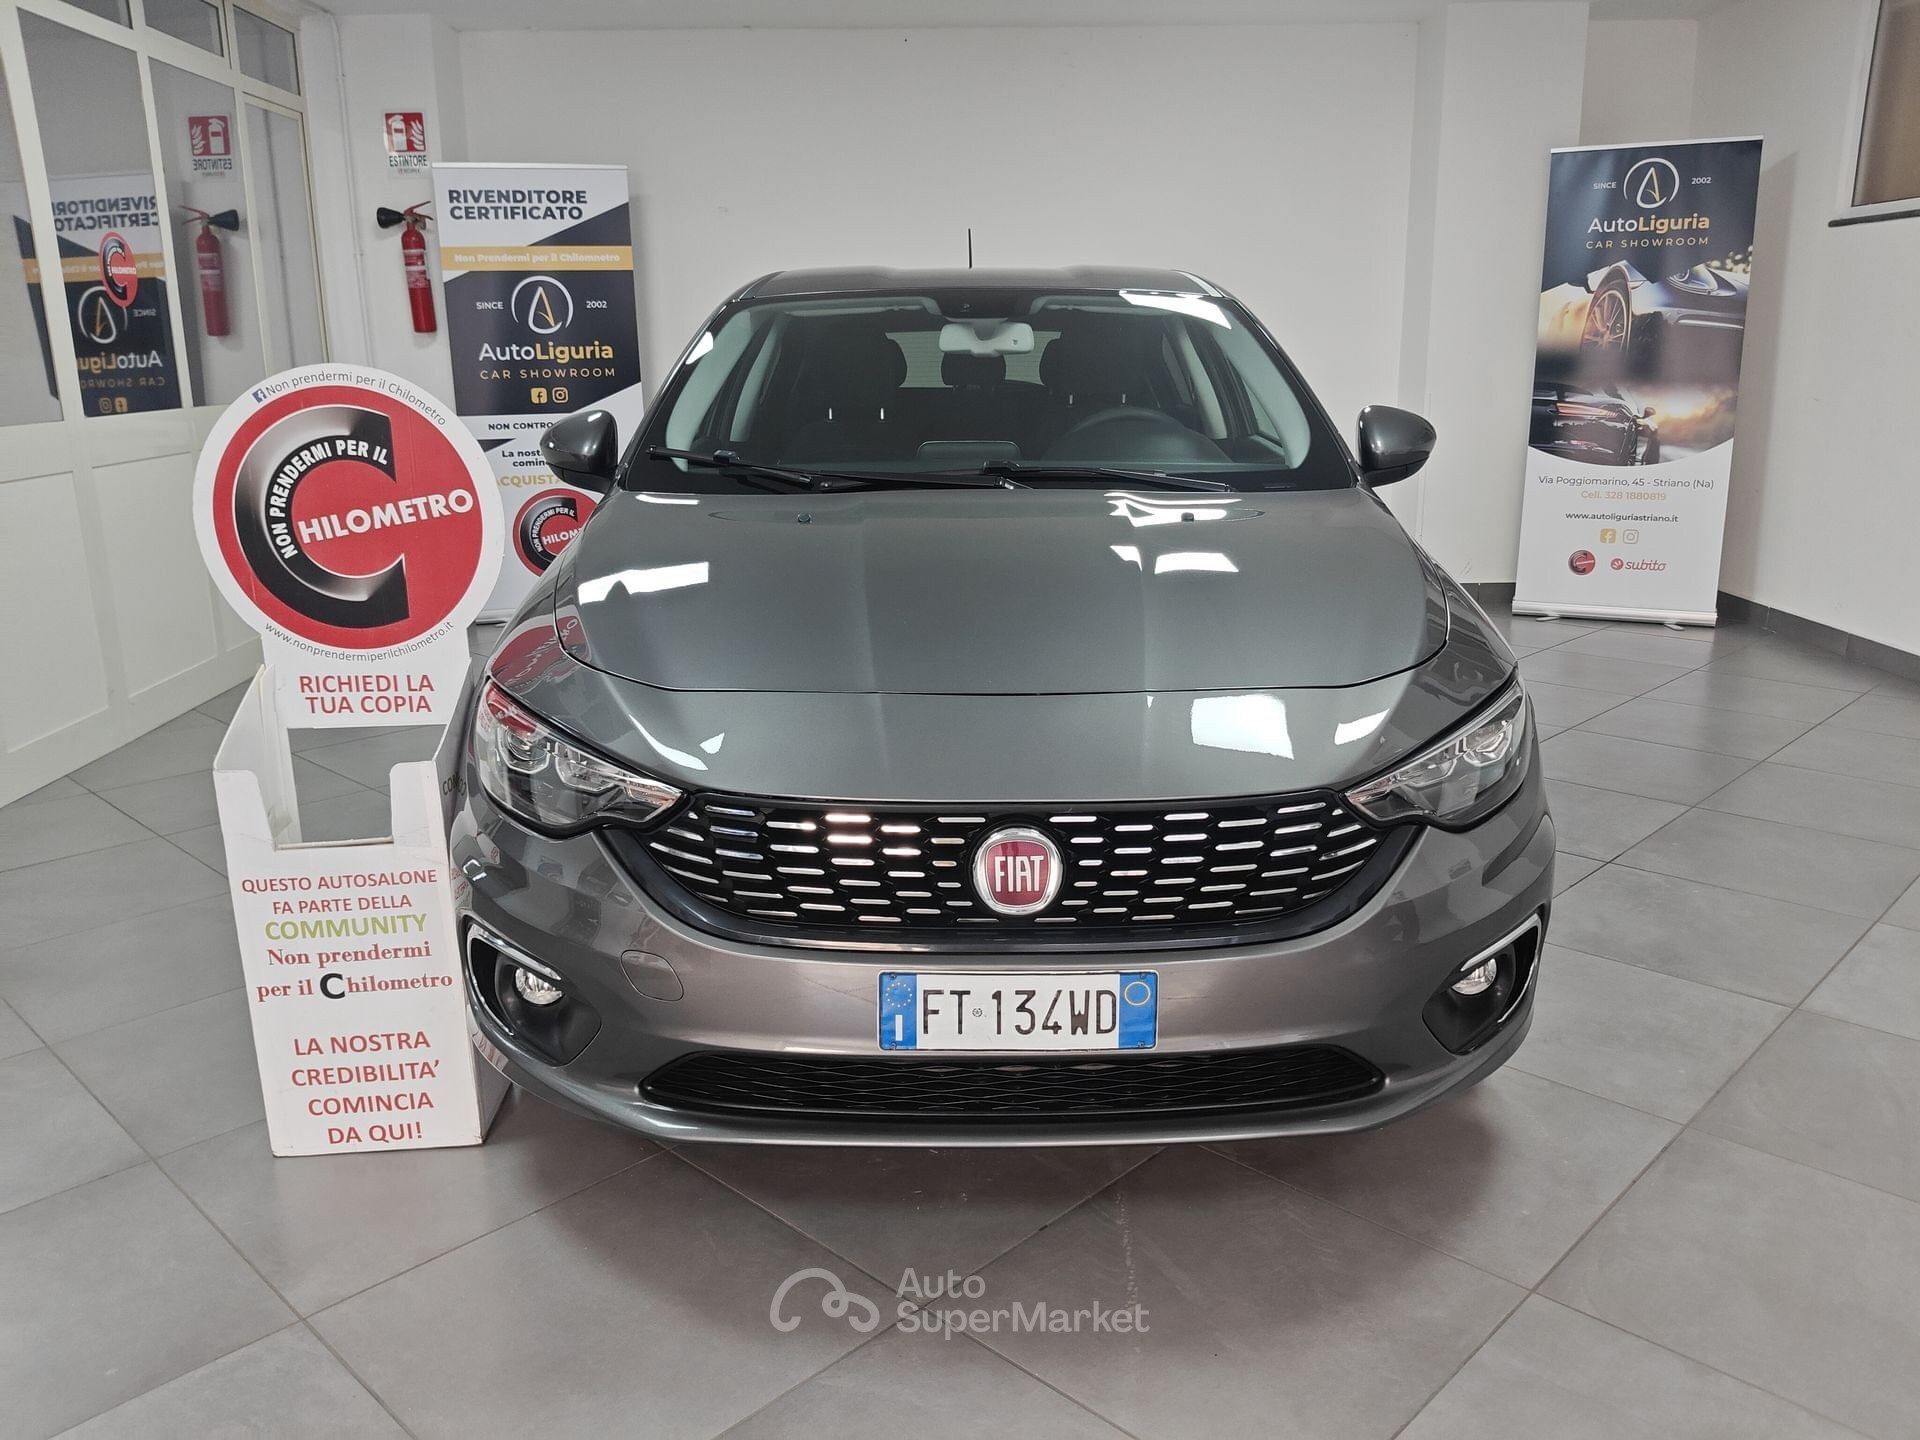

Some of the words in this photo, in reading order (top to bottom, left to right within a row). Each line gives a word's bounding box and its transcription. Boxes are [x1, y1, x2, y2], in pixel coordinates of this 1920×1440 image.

[389, 154, 428, 167] ESTINTORE
[1593, 182, 1617, 190] SINCE
[1691, 177, 1712, 185] 2002
[448, 189, 588, 204] RIVENDITORE
[450, 206, 583, 221] CERTIFICATO
[1587, 212, 1711, 235] AutoLiguria
[1585, 240, 1614, 250] CAR
[1621, 236, 1710, 249] SHOWROOM
[454, 253, 475, 263] Non
[478, 252, 530, 262] Prendermi
[532, 254, 548, 264] per
[476, 301, 504, 310] SINCE
[586, 301, 608, 309] 2002
[479, 340, 614, 364] AutoLiguria
[480, 370, 511, 380] CAR
[520, 368, 616, 379] SHOWROOM
[266, 380, 290, 397] Non
[293, 371, 352, 391] prendermi
[356, 374, 377, 387] per
[378, 377, 386, 389] il
[388, 383, 446, 427] Chilometro
[488, 423, 511, 431] NON
[336, 439, 368, 457] PER
[373, 446, 389, 465] IL
[502, 450, 515, 458] La
[269, 442, 332, 518] PRENDERMI
[496, 474, 561, 488] CQUIST
[1538, 476, 1554, 485] Via
[1556, 476, 1630, 488] Poggiomarino,
[1632, 478, 1645, 487] 45
[1653, 478, 1691, 488] Striano
[1692, 479, 1714, 490] (Na)
[1581, 490, 1602, 499] Cell.
[1605, 491, 1623, 500] 328
[297, 489, 474, 544] HILOMETRO
[532, 508, 556, 538] PRENDERMI
[1565, 511, 1679, 523] www.autoliguriastriano.it
[272, 523, 298, 559] NON
[533, 539, 544, 552] NON
[1625, 558, 1667, 571] subito
[265, 621, 455, 663] www.nonprendermiperilchilometro.it
[300, 674, 398, 693] RICHIEDI
[406, 674, 434, 692] LA
[305, 696, 353, 714] TUA
[361, 695, 432, 713] COPIA
[241, 876, 312, 894] QUESTO
[317, 869, 437, 890] AUTOSALONE
[994, 855, 1044, 893] FIAT
[272, 900, 294, 915] FA
[299, 897, 352, 914] PARTE
[358, 894, 412, 911] DELLA
[265, 913, 427, 940] COMMUNITY
[267, 948, 310, 967] Non
[317, 941, 432, 969] prendermi
[256, 984, 291, 1003] per
[297, 979, 314, 997] il
[319, 972, 453, 999] Chilometro
[922, 989, 971, 1035] FT
[991, 989, 1117, 1036] 134WD
[293, 1038, 324, 1056] LA
[330, 1030, 431, 1055] NOSTRA
[291, 1060, 440, 1087] CREDIBILITA'
[307, 1092, 434, 1116] COMINCIA
[327, 1127, 362, 1145] DA
[368, 1121, 423, 1144] QUI!
